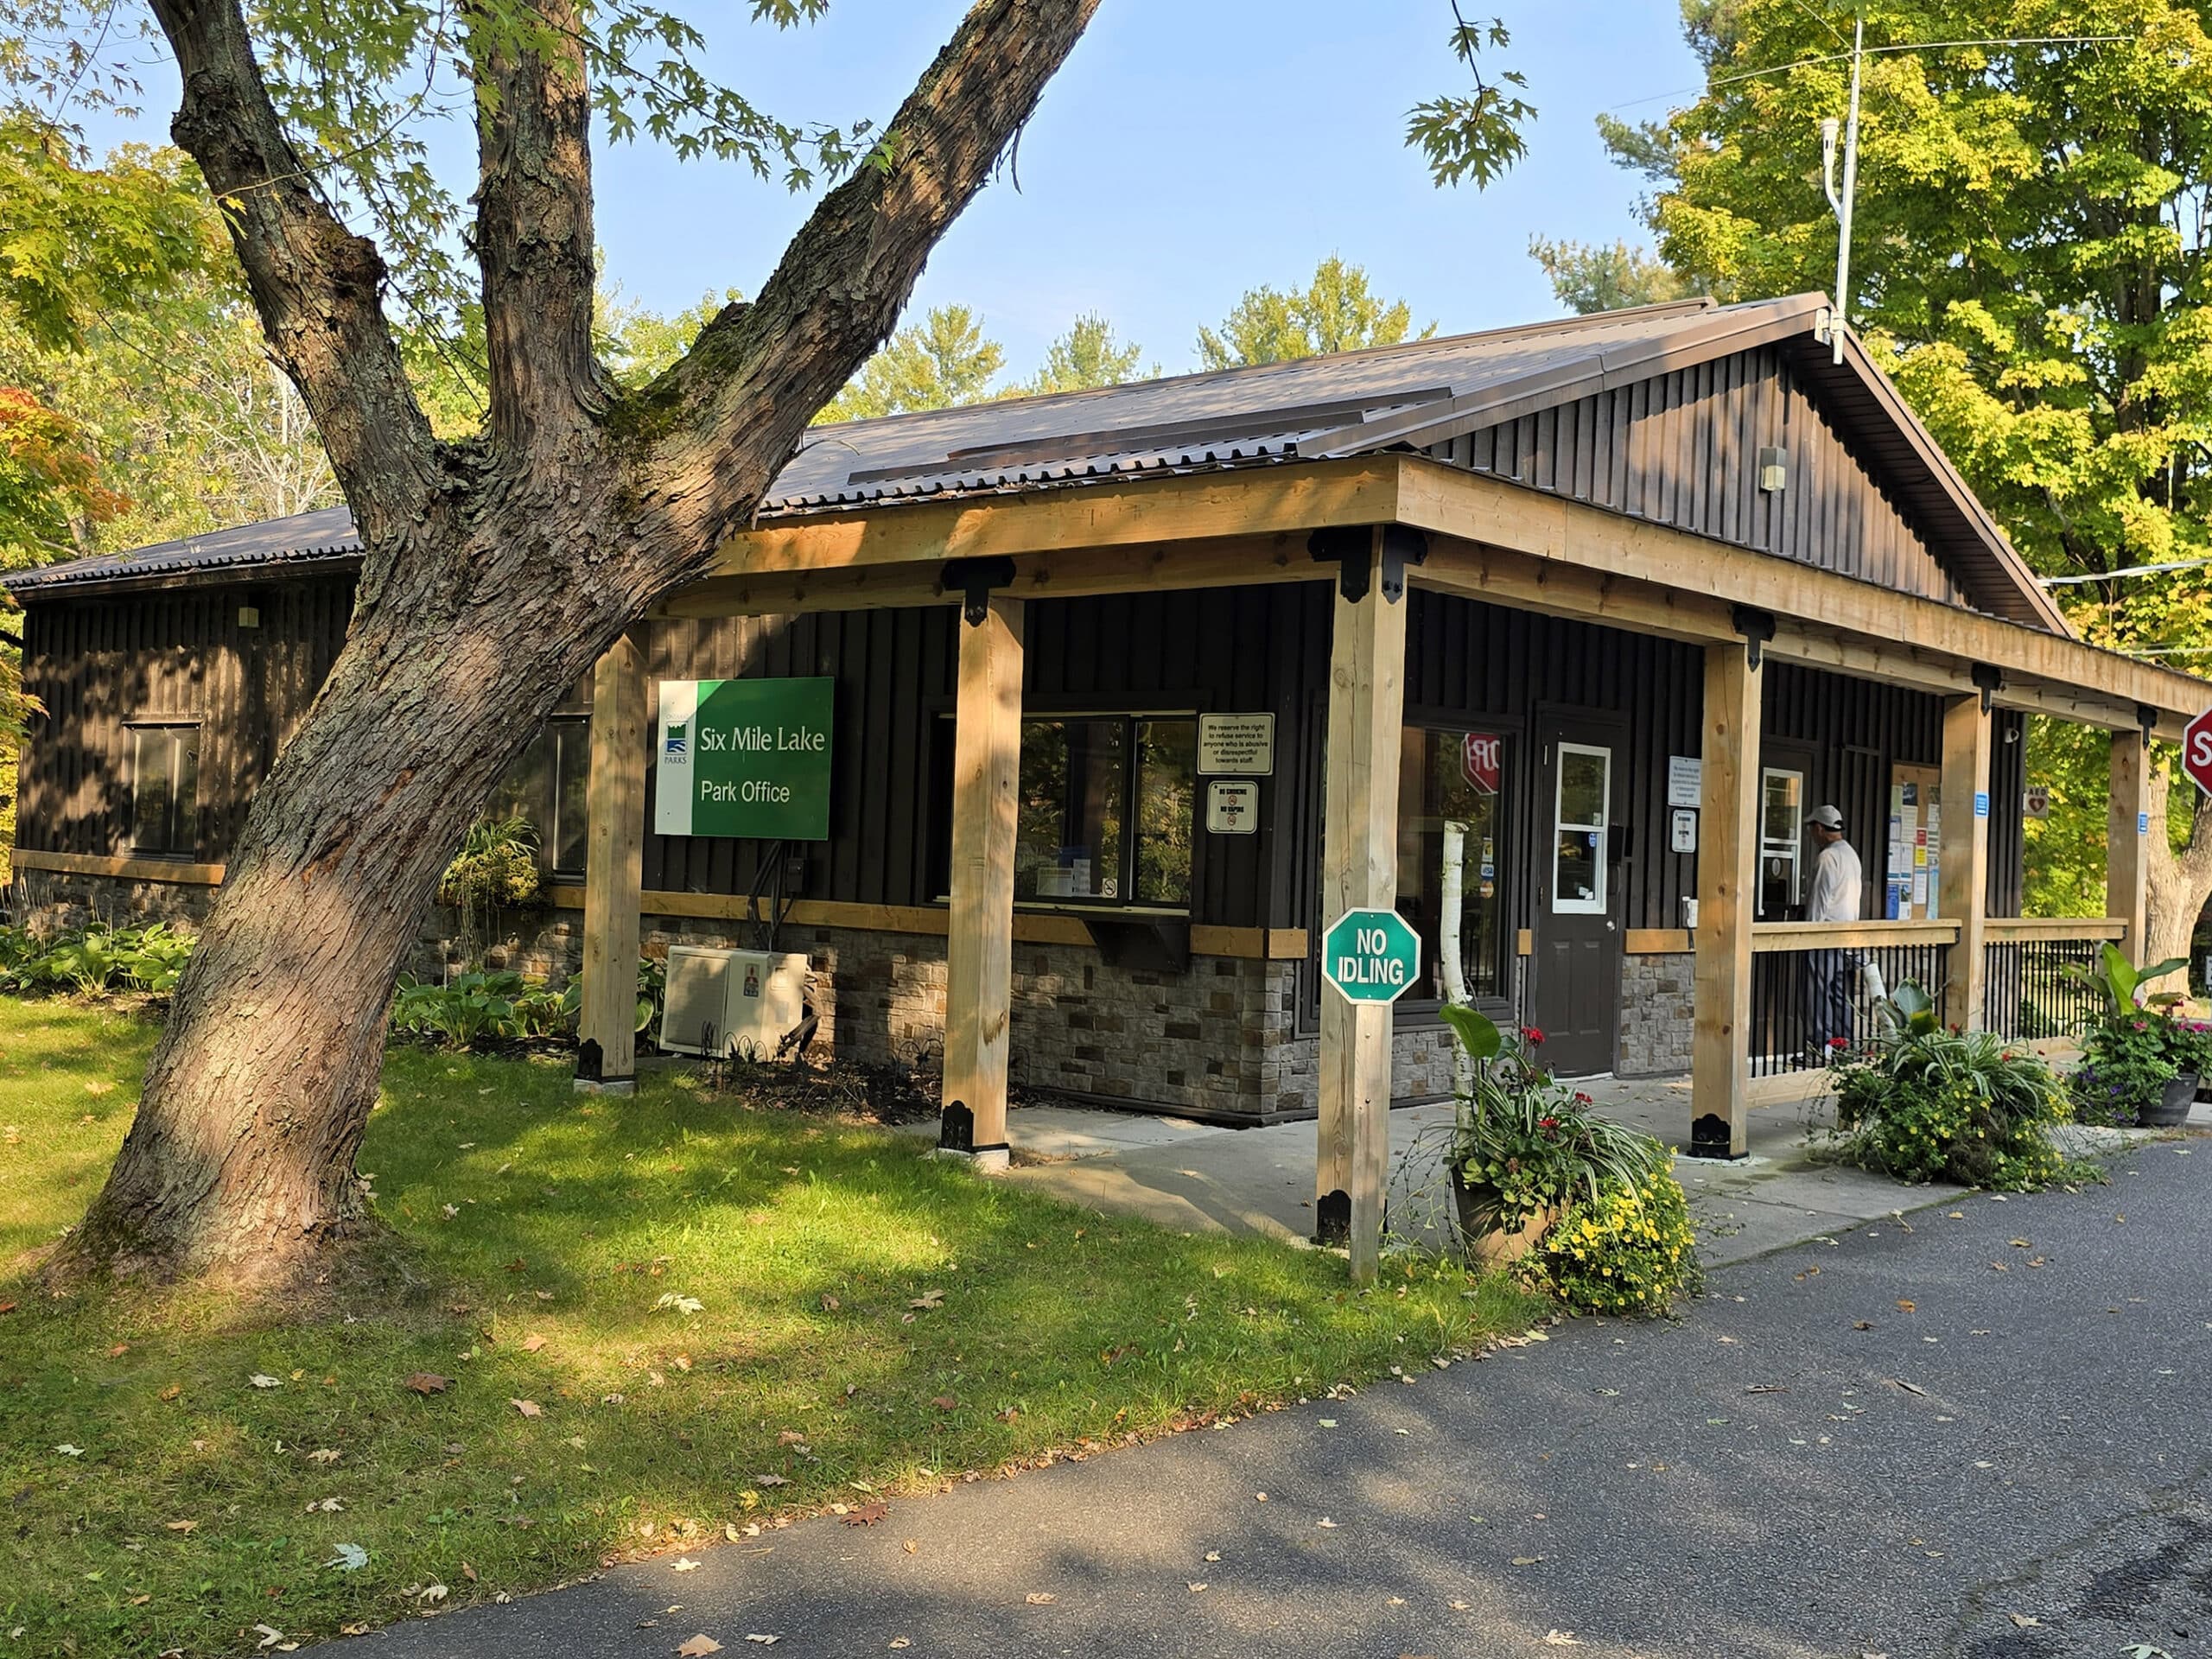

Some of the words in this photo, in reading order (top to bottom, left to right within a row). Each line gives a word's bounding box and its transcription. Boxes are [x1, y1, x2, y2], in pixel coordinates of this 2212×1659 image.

[701, 727, 726, 751] Six
[731, 726, 772, 751] Mile
[778, 726, 825, 751] Lake
[664, 756, 687, 765] PARKS
[701, 780, 737, 802] Park
[741, 780, 791, 803] Office
[1357, 928, 1387, 956] NO
[1338, 957, 1404, 985] IDLING
